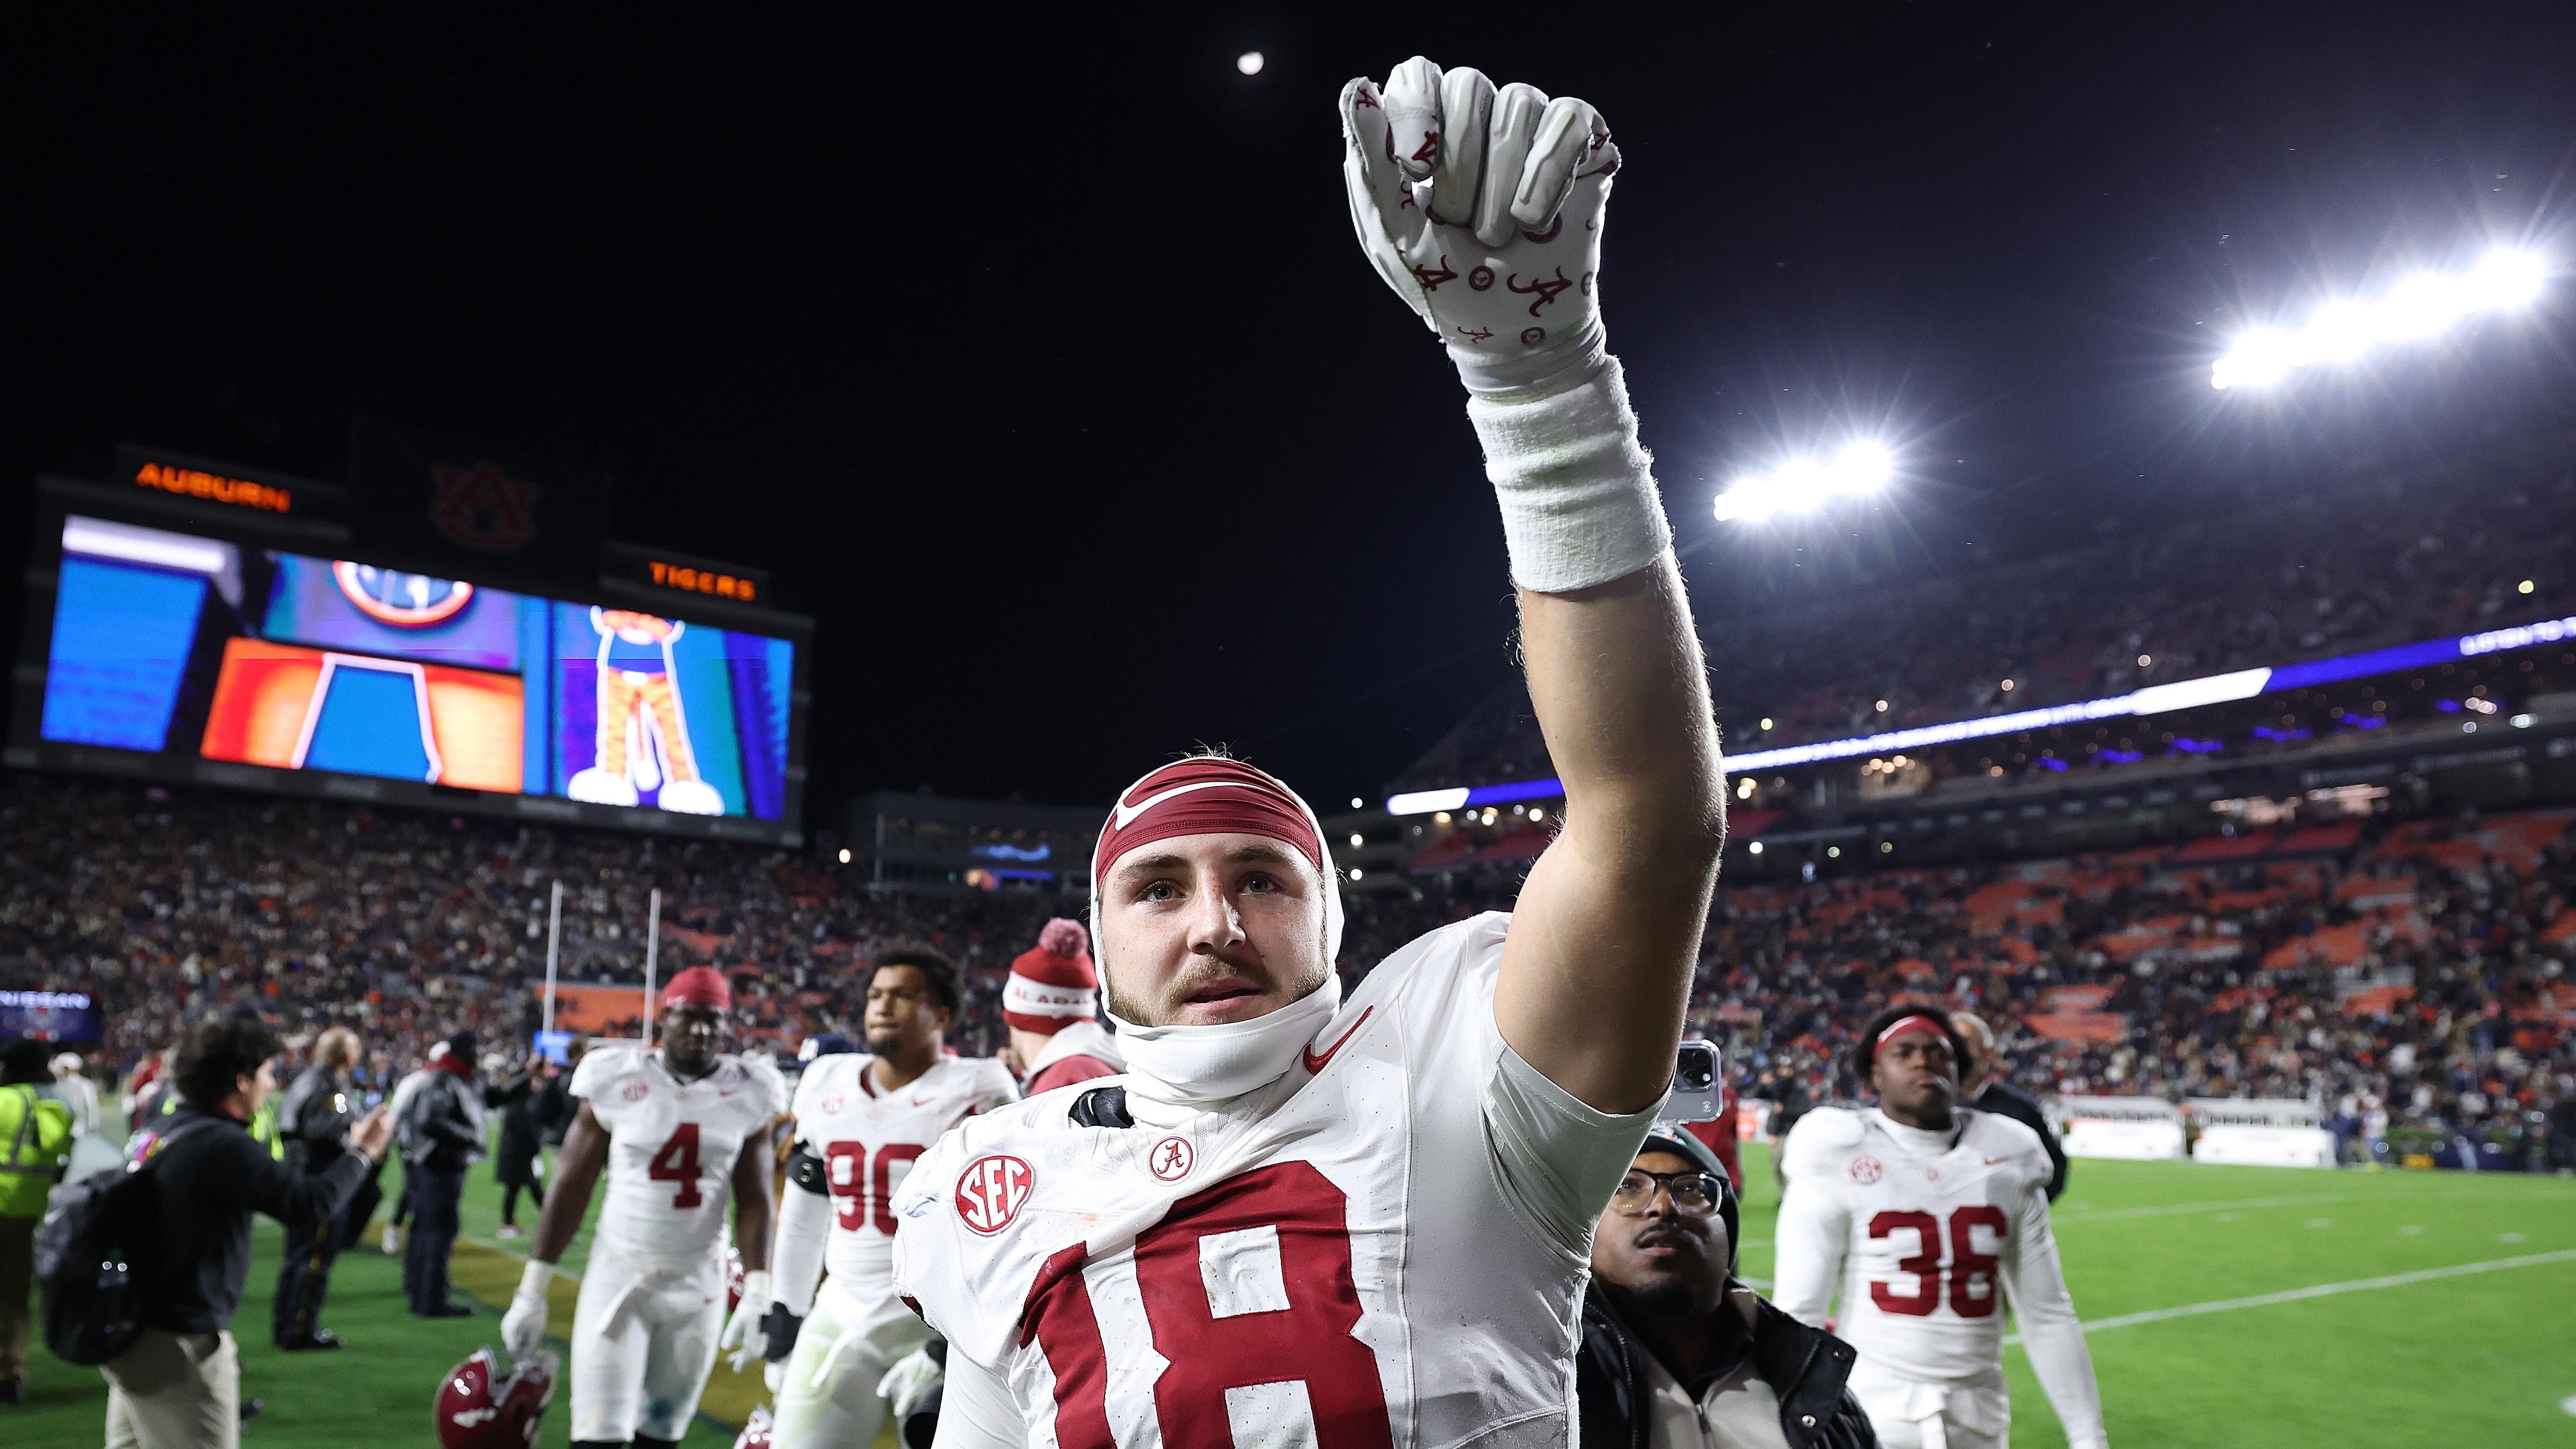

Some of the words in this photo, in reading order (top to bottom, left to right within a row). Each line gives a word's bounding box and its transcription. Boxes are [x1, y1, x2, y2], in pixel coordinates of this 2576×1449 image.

[1506, 265, 1573, 317] A
[136, 462, 292, 513] AUBURN
[649, 561, 756, 602] TIGERS
[649, 1122, 703, 1208] 4
[824, 1140, 927, 1237] 90
[1157, 1141, 1184, 1174] A
[960, 1158, 1027, 1229] SEC
[1869, 1206, 2006, 1317] 36
[1018, 1160, 1392, 1449] 18
